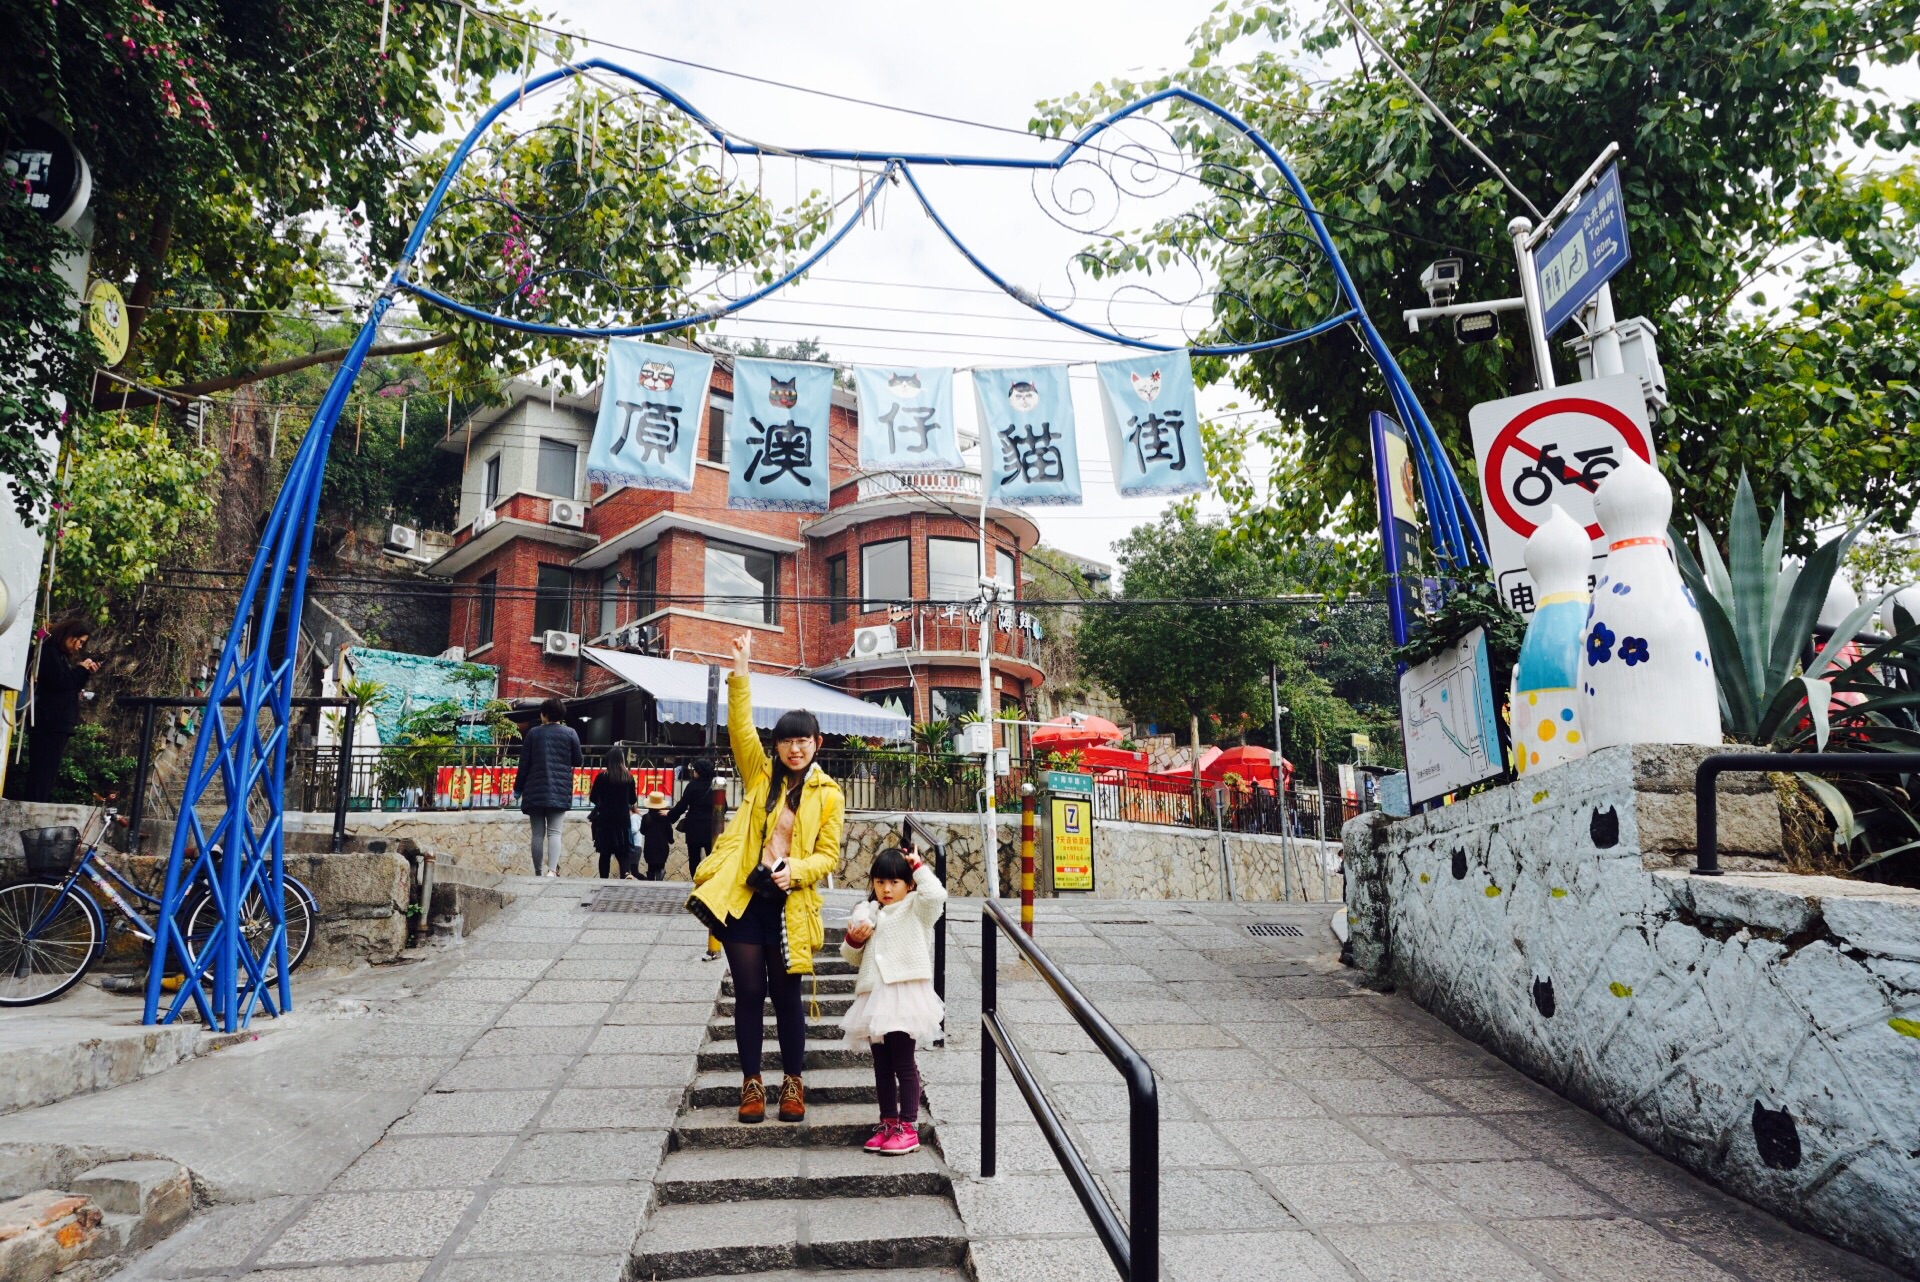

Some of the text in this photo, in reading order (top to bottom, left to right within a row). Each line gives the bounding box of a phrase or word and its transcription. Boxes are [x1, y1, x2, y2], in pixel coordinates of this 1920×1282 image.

[1588, 209, 1614, 241] Toilet
[1592, 237, 1611, 260] 150m
[1067, 808, 1076, 824] 7
